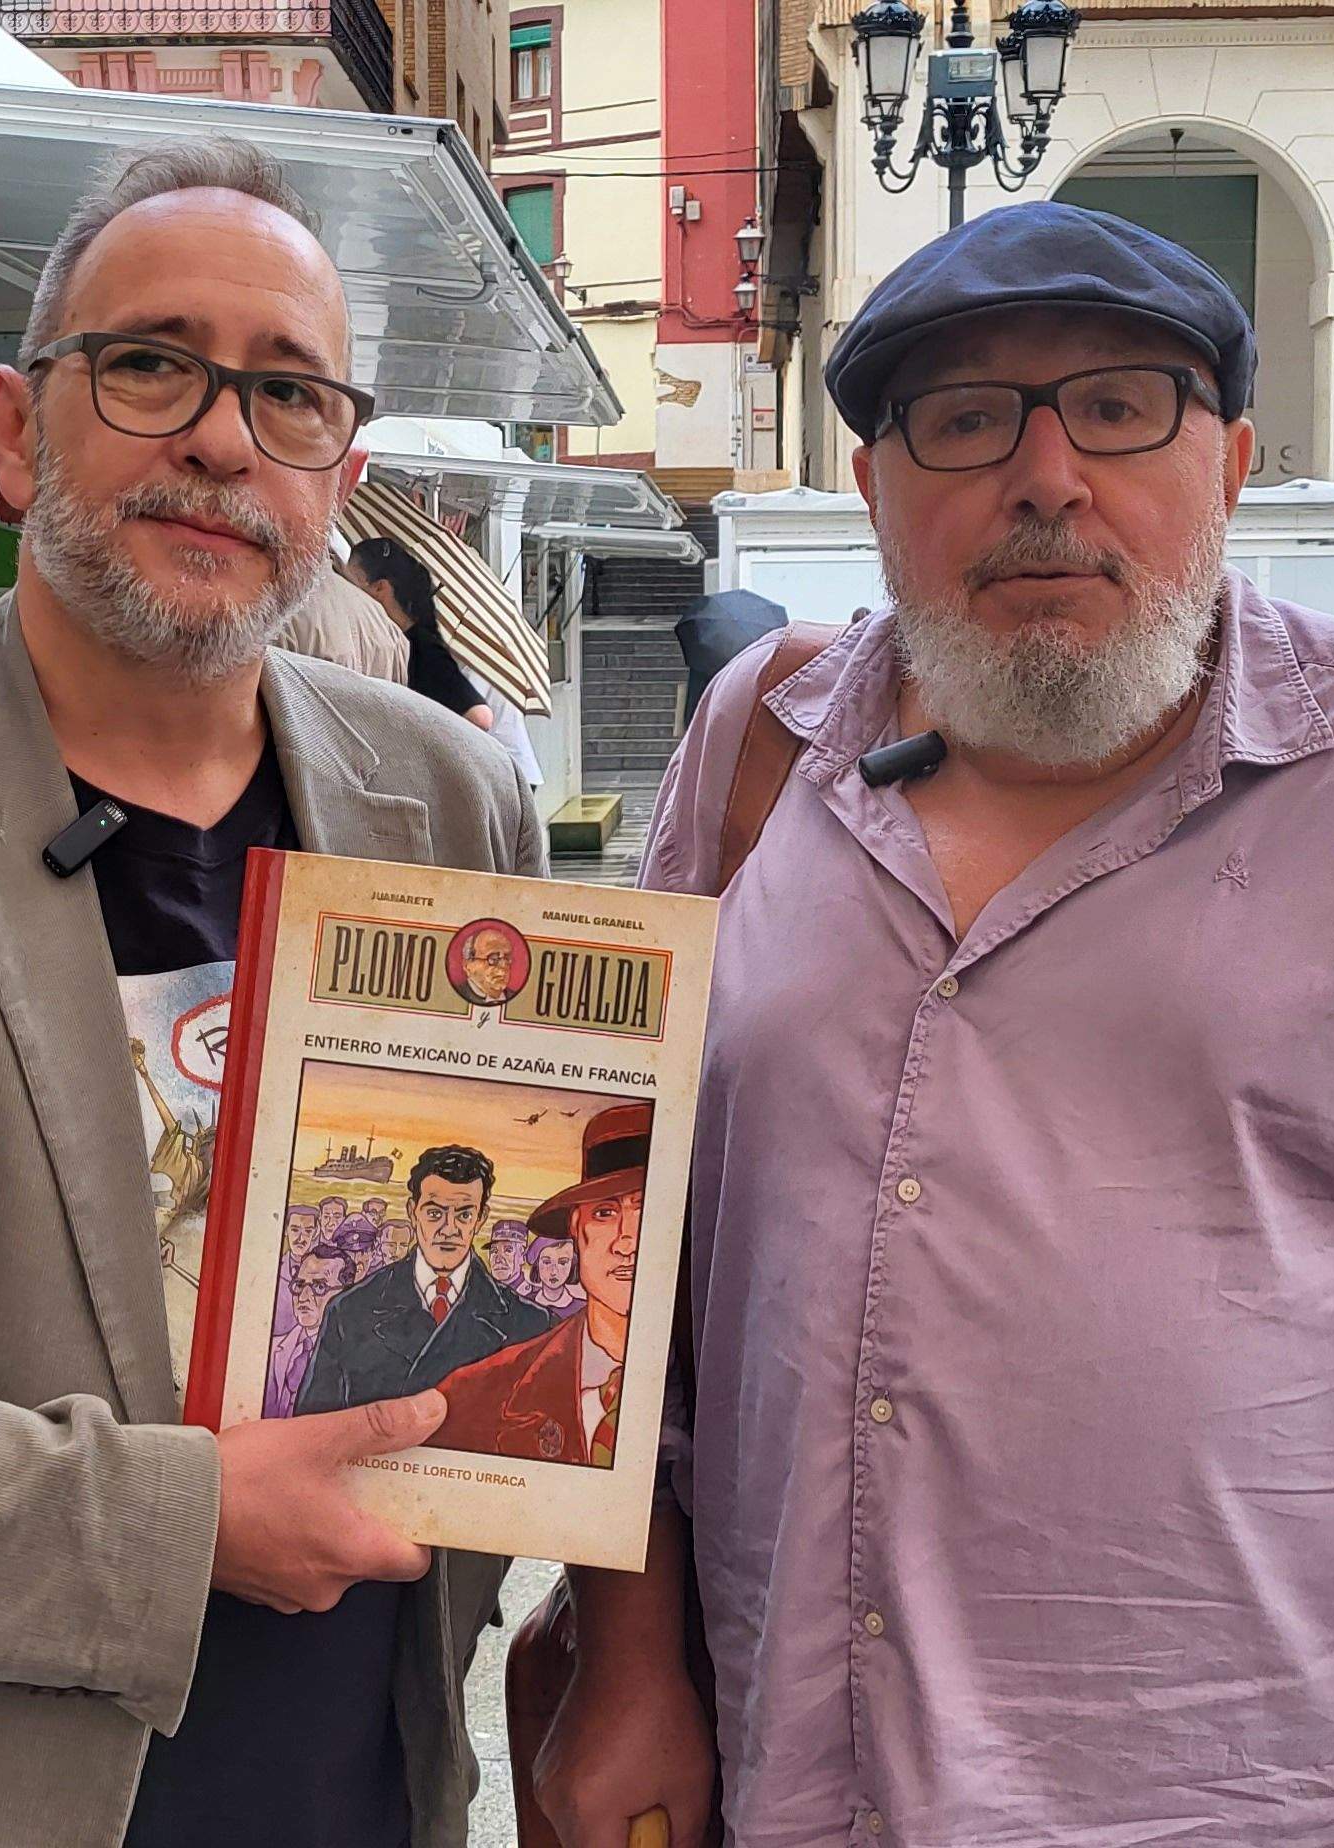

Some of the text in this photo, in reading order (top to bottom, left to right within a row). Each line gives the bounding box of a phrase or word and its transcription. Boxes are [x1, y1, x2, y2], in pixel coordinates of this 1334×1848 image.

[542, 910, 645, 931] MANUEL GRANELL
[329, 926, 650, 1029] PLOMO y GUALDA
[304, 1034, 657, 1087] ENTIERRO MEXICANO DE AZAÑA EN FRANCIA
[403, 1462, 420, 1474] DE
[424, 1465, 471, 1481] LORETO
[476, 1469, 527, 1488] URRACA
